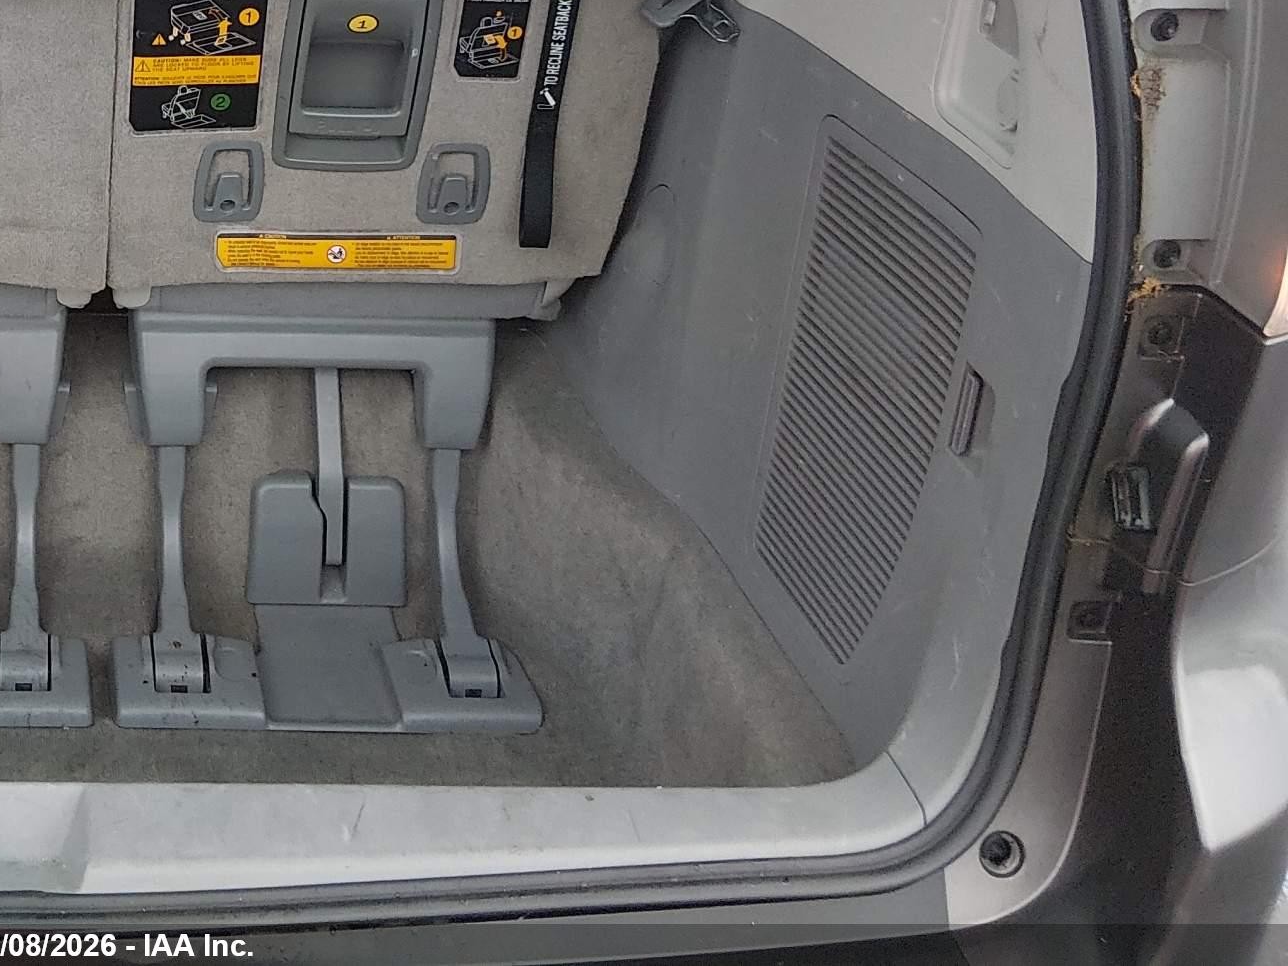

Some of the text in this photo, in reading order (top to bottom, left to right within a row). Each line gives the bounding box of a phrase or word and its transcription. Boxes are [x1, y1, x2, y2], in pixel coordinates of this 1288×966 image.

[245, 11, 252, 23] 1
[356, 20, 368, 29] 1
[544, 0, 573, 86] TO RECLINE SEATBACK
[215, 96, 226, 108] 2
